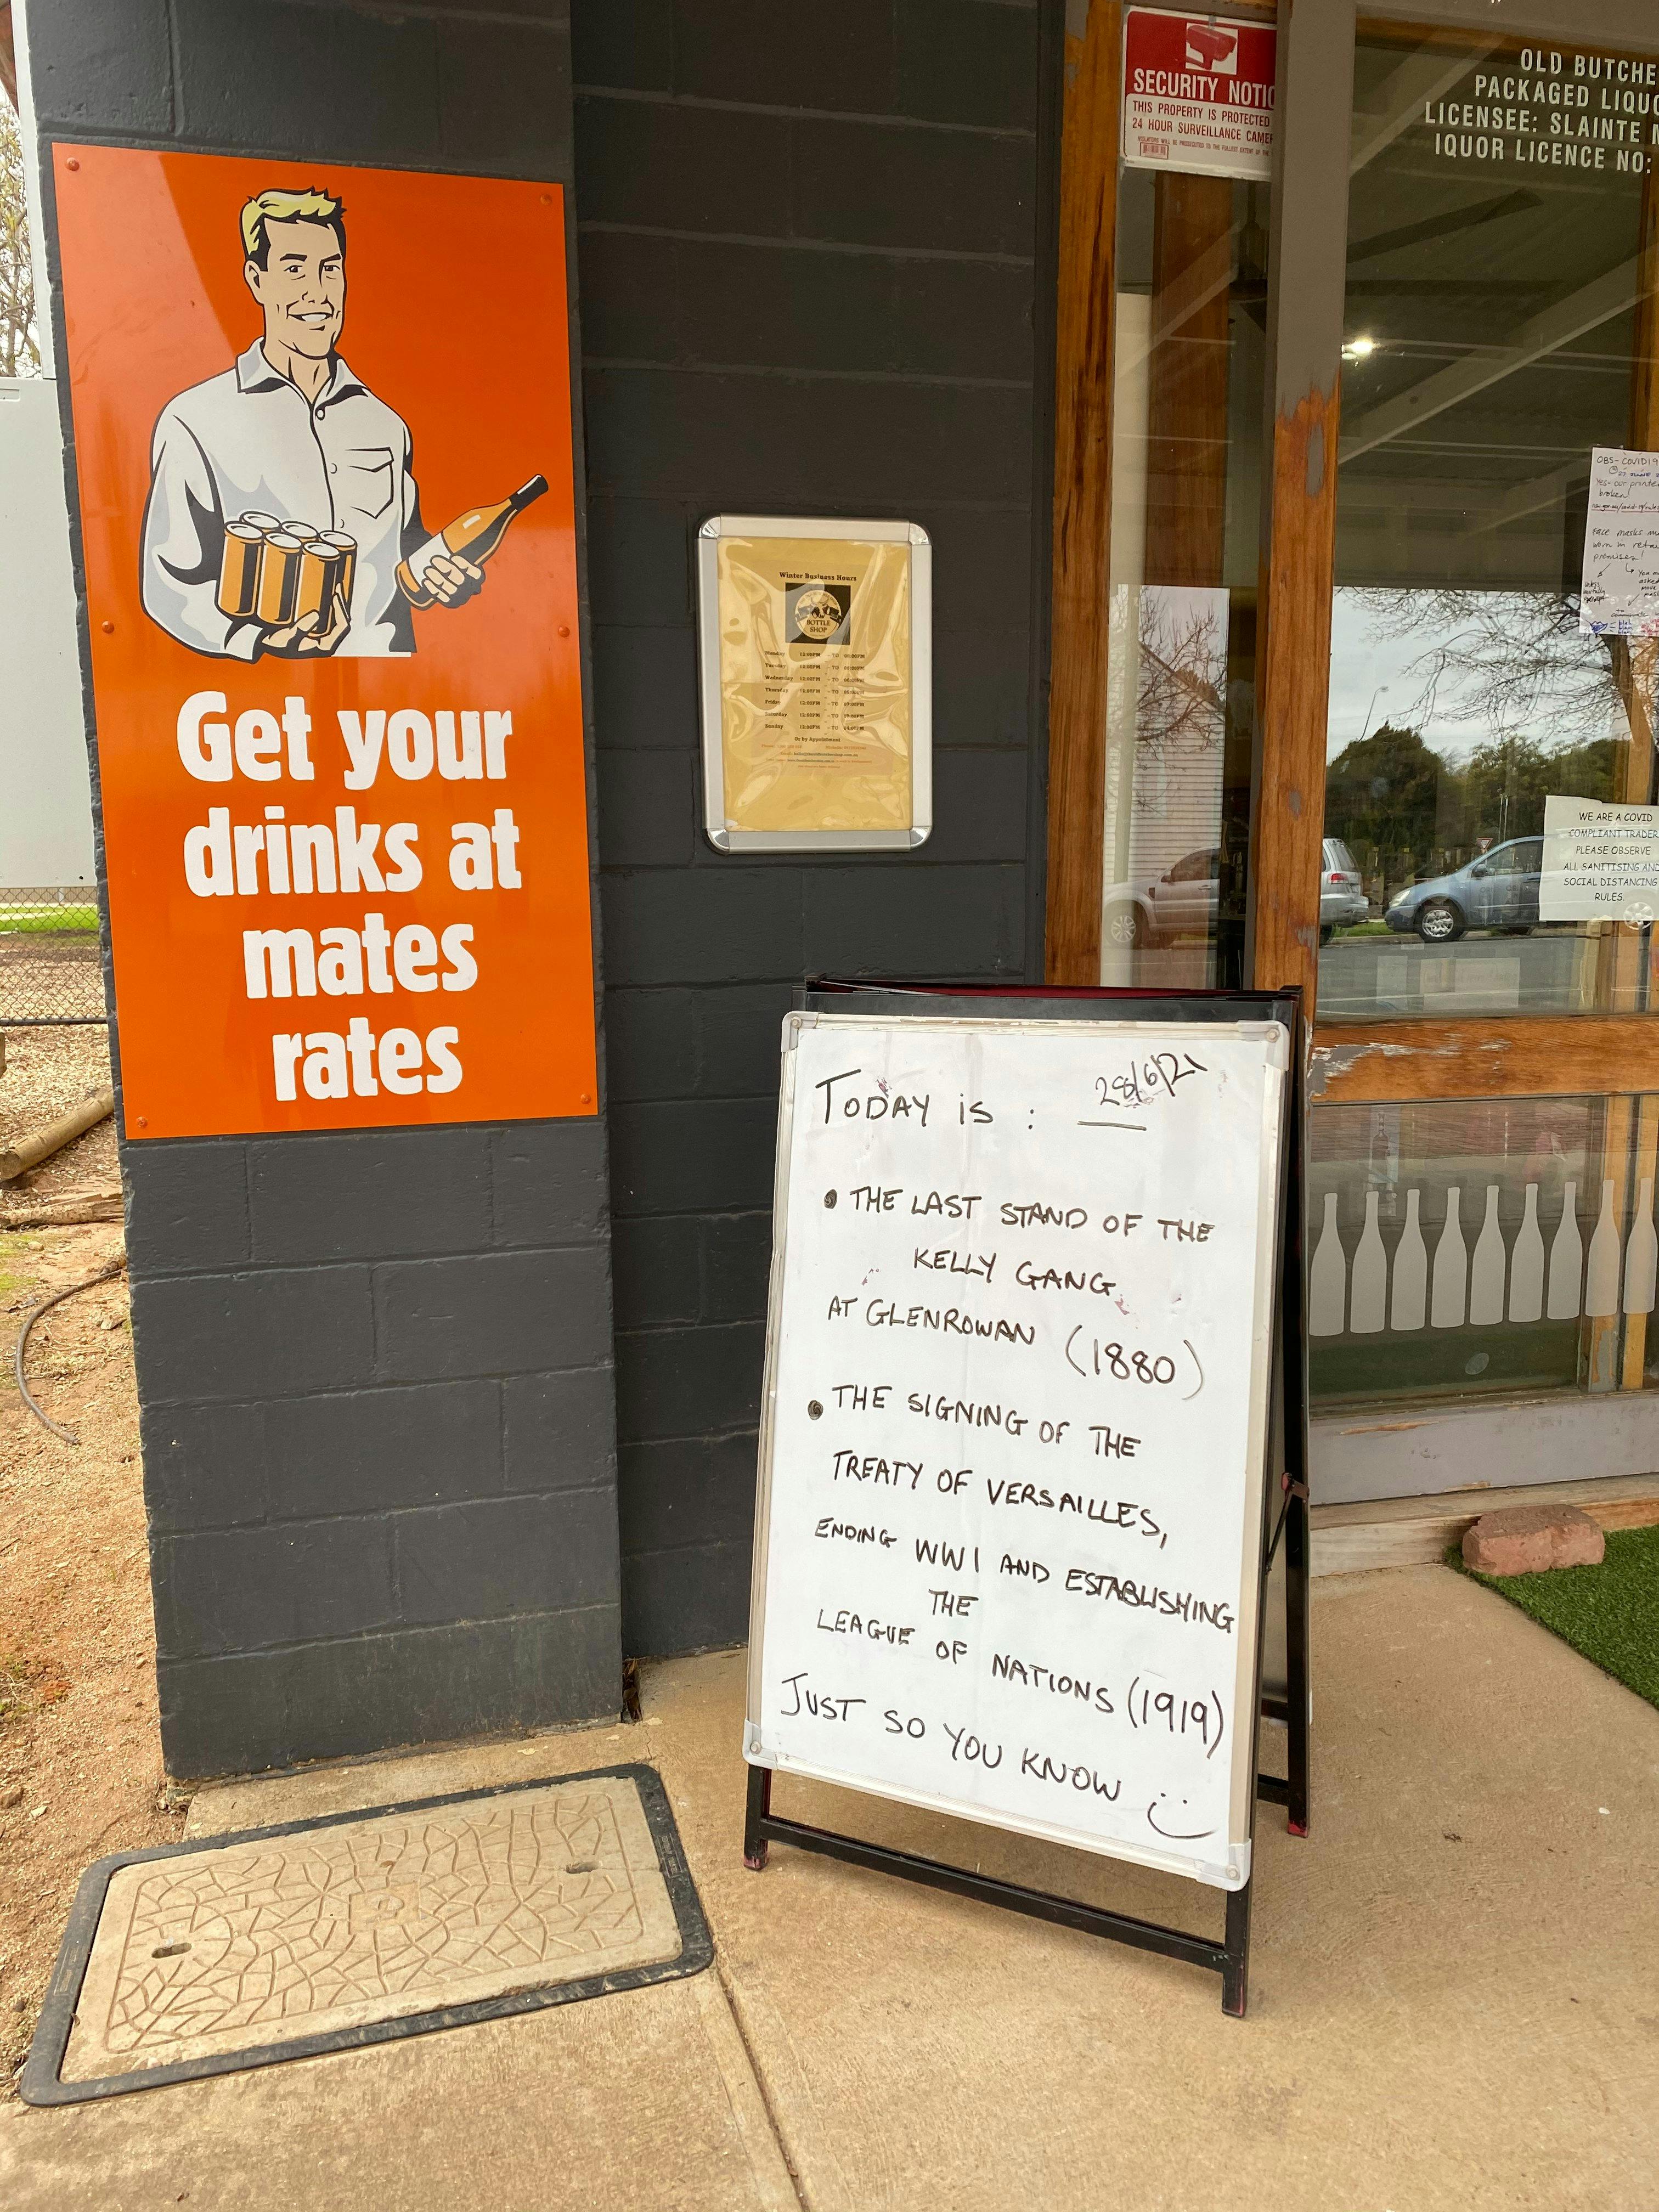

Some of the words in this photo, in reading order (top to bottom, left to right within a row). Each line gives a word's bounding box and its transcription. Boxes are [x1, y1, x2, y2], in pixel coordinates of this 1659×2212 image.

[1133, 67, 1218, 101] SECURITY
[1521, 48, 1562, 75] OLD
[1575, 54, 1656, 86] BUTCHE
[1475, 74, 1589, 107] PACKAGED
[1132, 117, 1143, 129] 24
[1148, 119, 1172, 132] HOUR
[1178, 122, 1241, 140] SURVEILLANCE
[1133, 100, 1153, 113] THIS
[1158, 103, 1203, 119] PROPERTY
[1208, 108, 1216, 121] IS
[1222, 110, 1270, 127] PROTECTED
[1425, 101, 1537, 133] LICENSEE:
[1550, 112, 1640, 143] SLAINTE
[1435, 133, 1504, 160] IQUOR
[1516, 139, 1605, 169] LICENCE
[1617, 149, 1652, 174] NO:
[177, 691, 314, 782] Get
[336, 709, 512, 791] your
[1570, 829, 1622, 838] COMPLIANT
[1579, 812, 1593, 821] WE
[1596, 812, 1613, 821] ARE
[1616, 812, 1621, 821] A
[1624, 813, 1653, 822] COVID
[184, 806, 423, 897] drinks
[449, 808, 522, 890] at
[1564, 862, 1579, 871] ALL
[1582, 862, 1640, 871] SANITISING
[1643, 863, 1659, 872] AND
[1576, 845, 1609, 855] PLEASE
[1611, 846, 1651, 855] OBSERVE
[1564, 877, 1597, 886] SOCIAL
[1600, 877, 1658, 887] DISTANCING
[1595, 893, 1625, 901] RULES.
[243, 912, 478, 999] mates
[273, 1017, 462, 1102] rates
[850, 1186, 903, 1212] THE
[911, 1192, 982, 1220] LAST
[1001, 1203, 1088, 1230] STAND
[1103, 1214, 1142, 1234] OF
[1158, 1217, 1216, 1243] THE
[913, 1246, 996, 1283] KELLY
[1015, 1261, 1117, 1296] GANG
[828, 1296, 857, 1321] AT
[866, 1299, 1036, 1346] GLENROWAN
[1065, 1324, 1205, 1401] (1880)
[832, 1384, 893, 1410] THE
[908, 1393, 1028, 1437] SIGNING
[1039, 1420, 1069, 1444] OF
[1088, 1425, 1142, 1459] THE
[832, 1449, 924, 1491] TREATY
[936, 1468, 974, 1496] OF
[987, 1478, 1169, 1550] VERSAILLES,
[814, 1517, 898, 1549] ENDING
[1000, 1554, 1051, 1584] AND
[1066, 1568, 1235, 1634] ESTABLISHING
[928, 1589, 979, 1618] THE
[816, 1608, 916, 1646] LEAGUE
[936, 1640, 968, 1666] OF
[992, 1654, 1115, 1715] NATIONS
[1126, 1675, 1226, 1760] (1919)
[780, 1673, 867, 1718] JUST
[884, 1709, 926, 1739] SO
[943, 1722, 1003, 1769] YOU
[1022, 1748, 1122, 1803] KNOW
